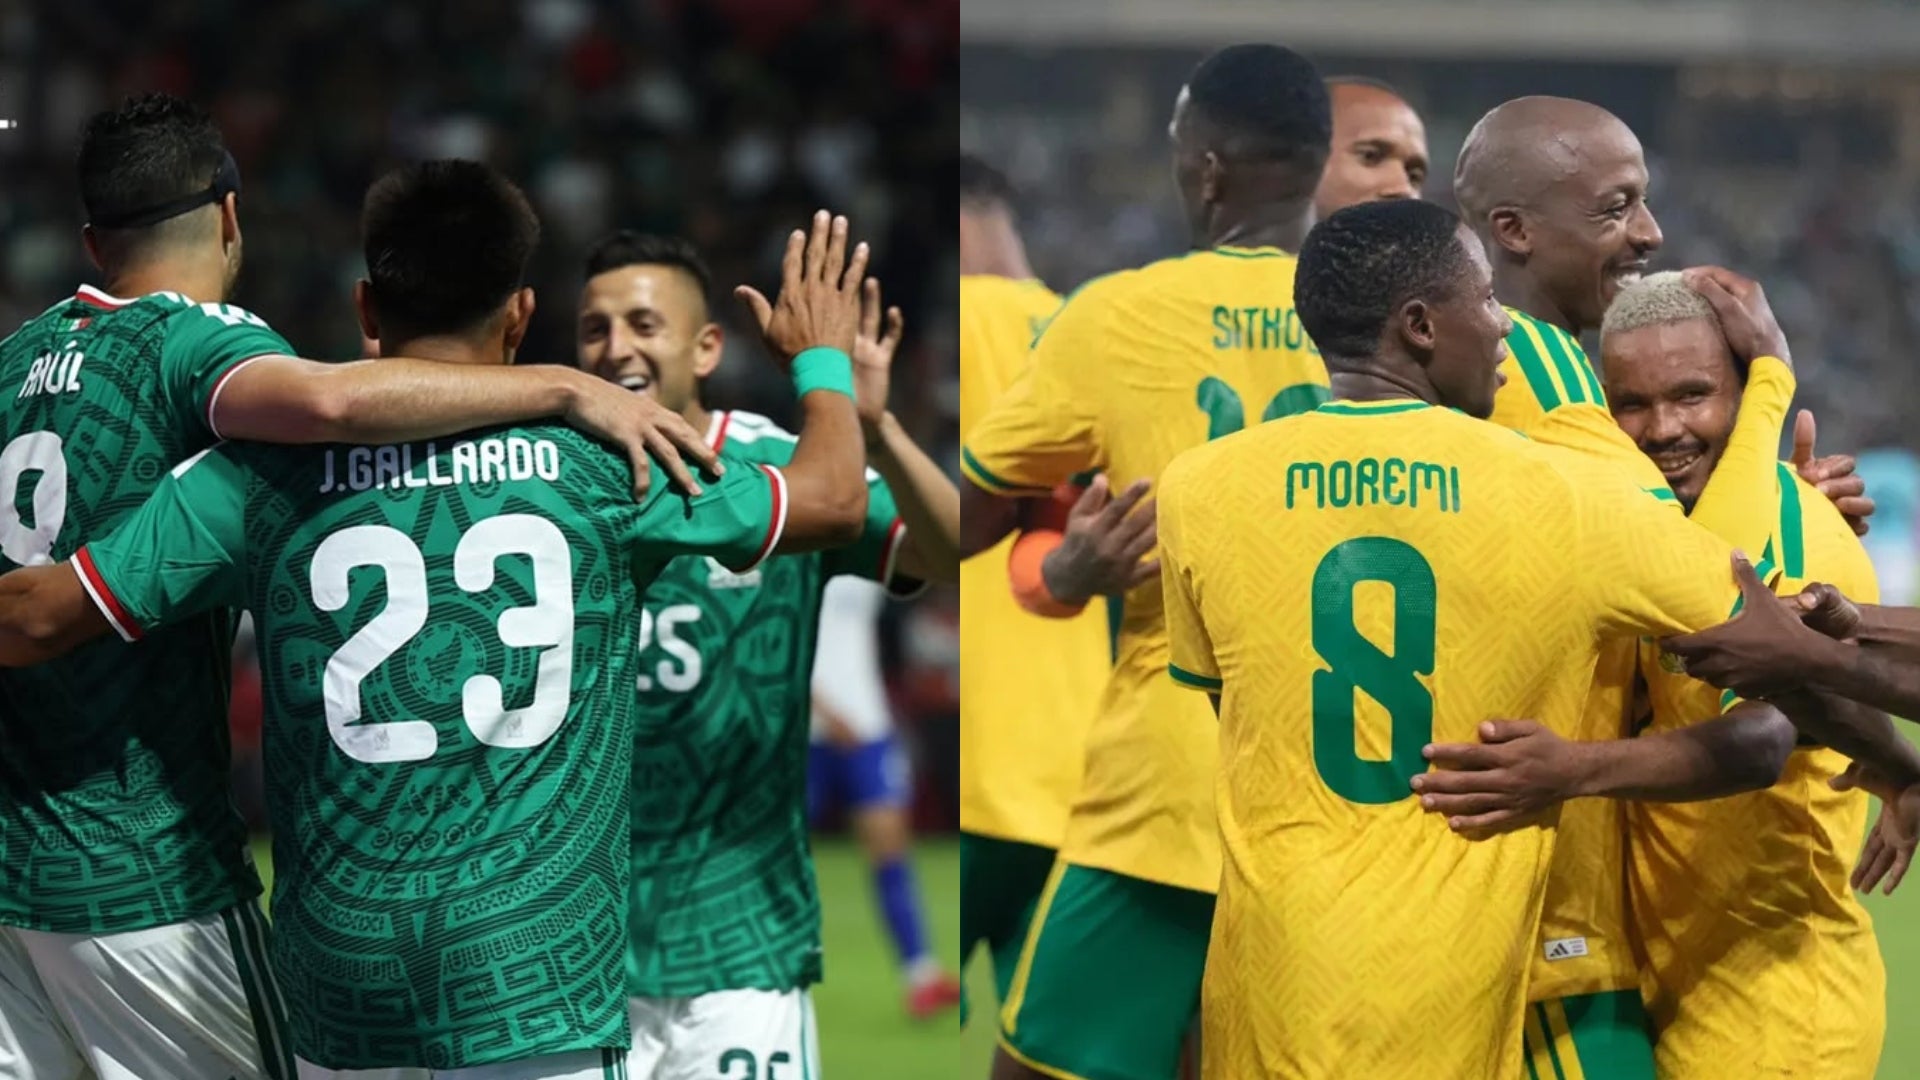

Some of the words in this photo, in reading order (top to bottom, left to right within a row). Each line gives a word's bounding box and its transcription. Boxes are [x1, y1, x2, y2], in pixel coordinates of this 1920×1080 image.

[319, 437, 560, 493] J.GALLARDO
[1286, 457, 1461, 513] MOREMI
[310, 513, 574, 763] 23
[1311, 536, 1437, 805] 8
